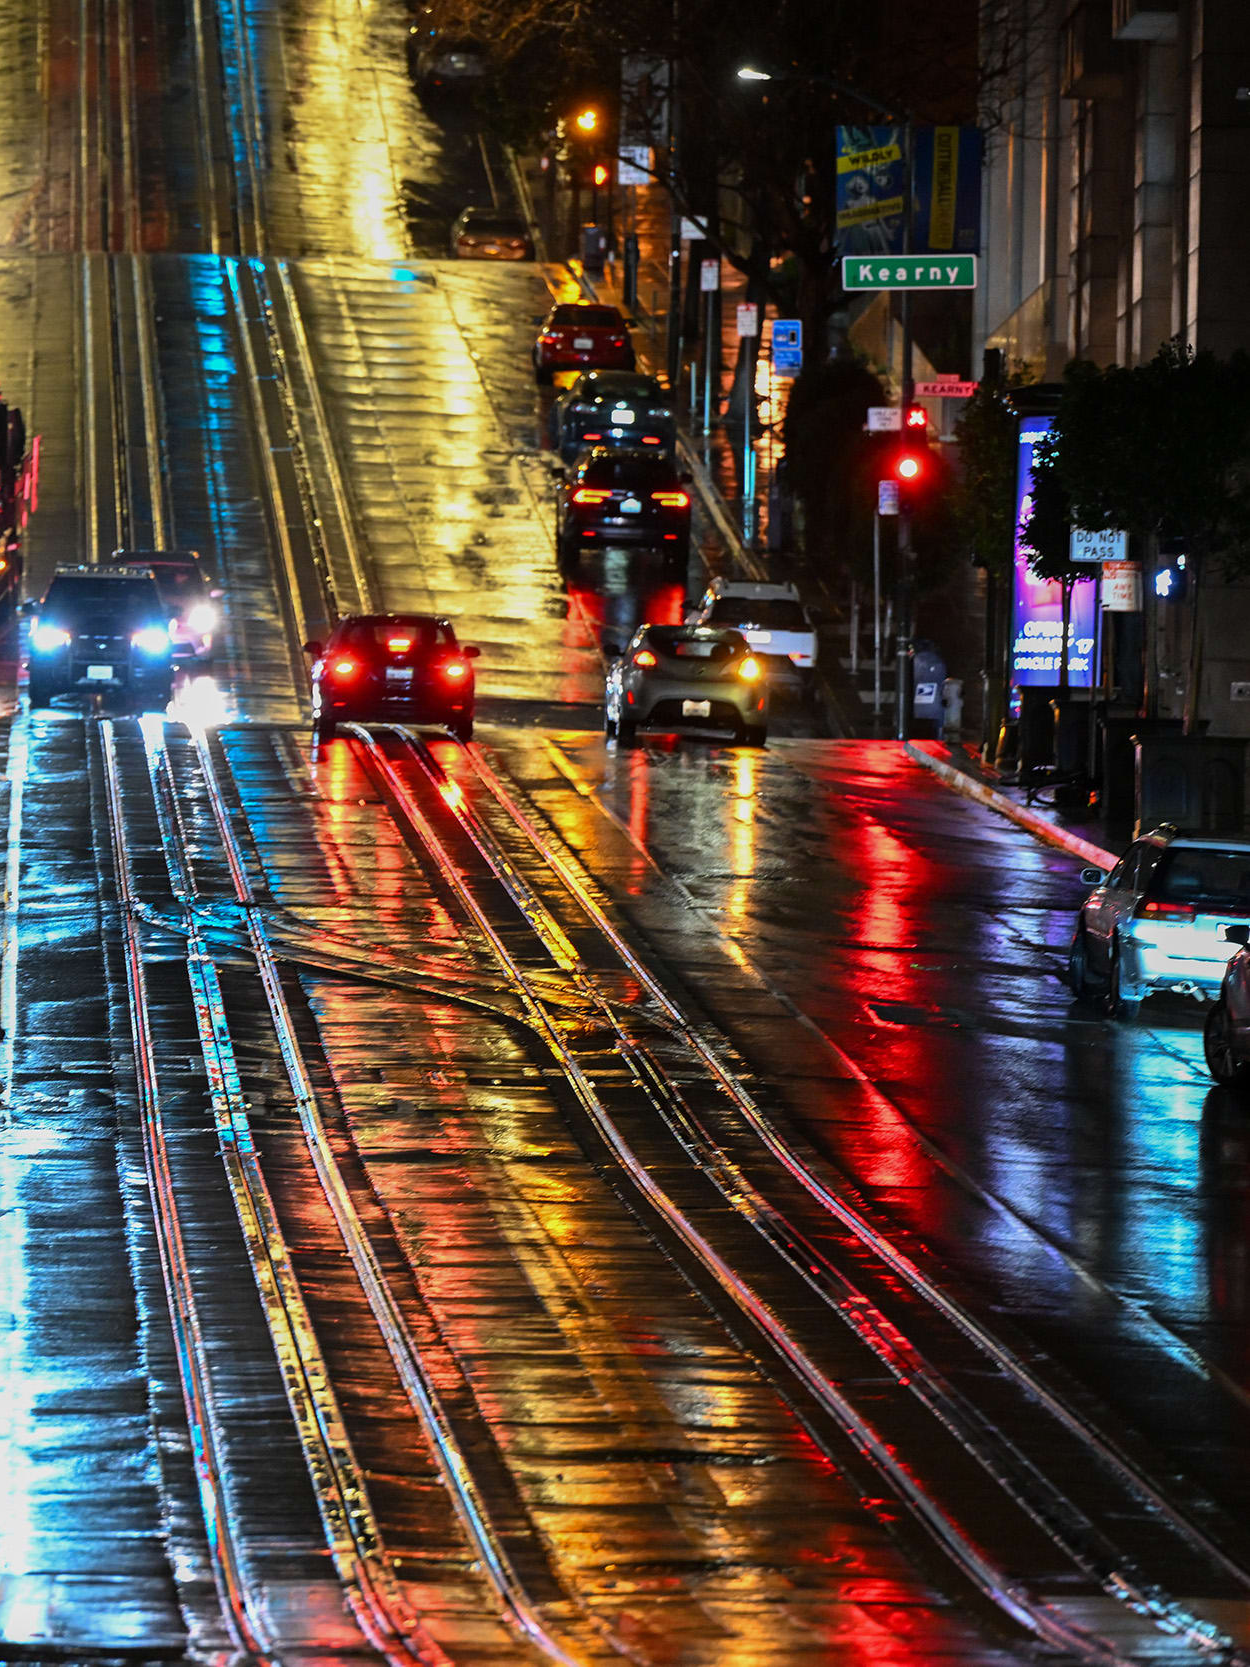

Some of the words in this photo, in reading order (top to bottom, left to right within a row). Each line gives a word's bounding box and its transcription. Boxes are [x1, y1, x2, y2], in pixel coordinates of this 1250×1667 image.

[859, 264, 959, 284] Kearny
[923, 385, 971, 394] KEARNY
[1076, 532, 1093, 543] DO
[1099, 531, 1122, 543] NOT
[1083, 547, 1115, 558] PASS
[1075, 639, 1094, 654] 17
